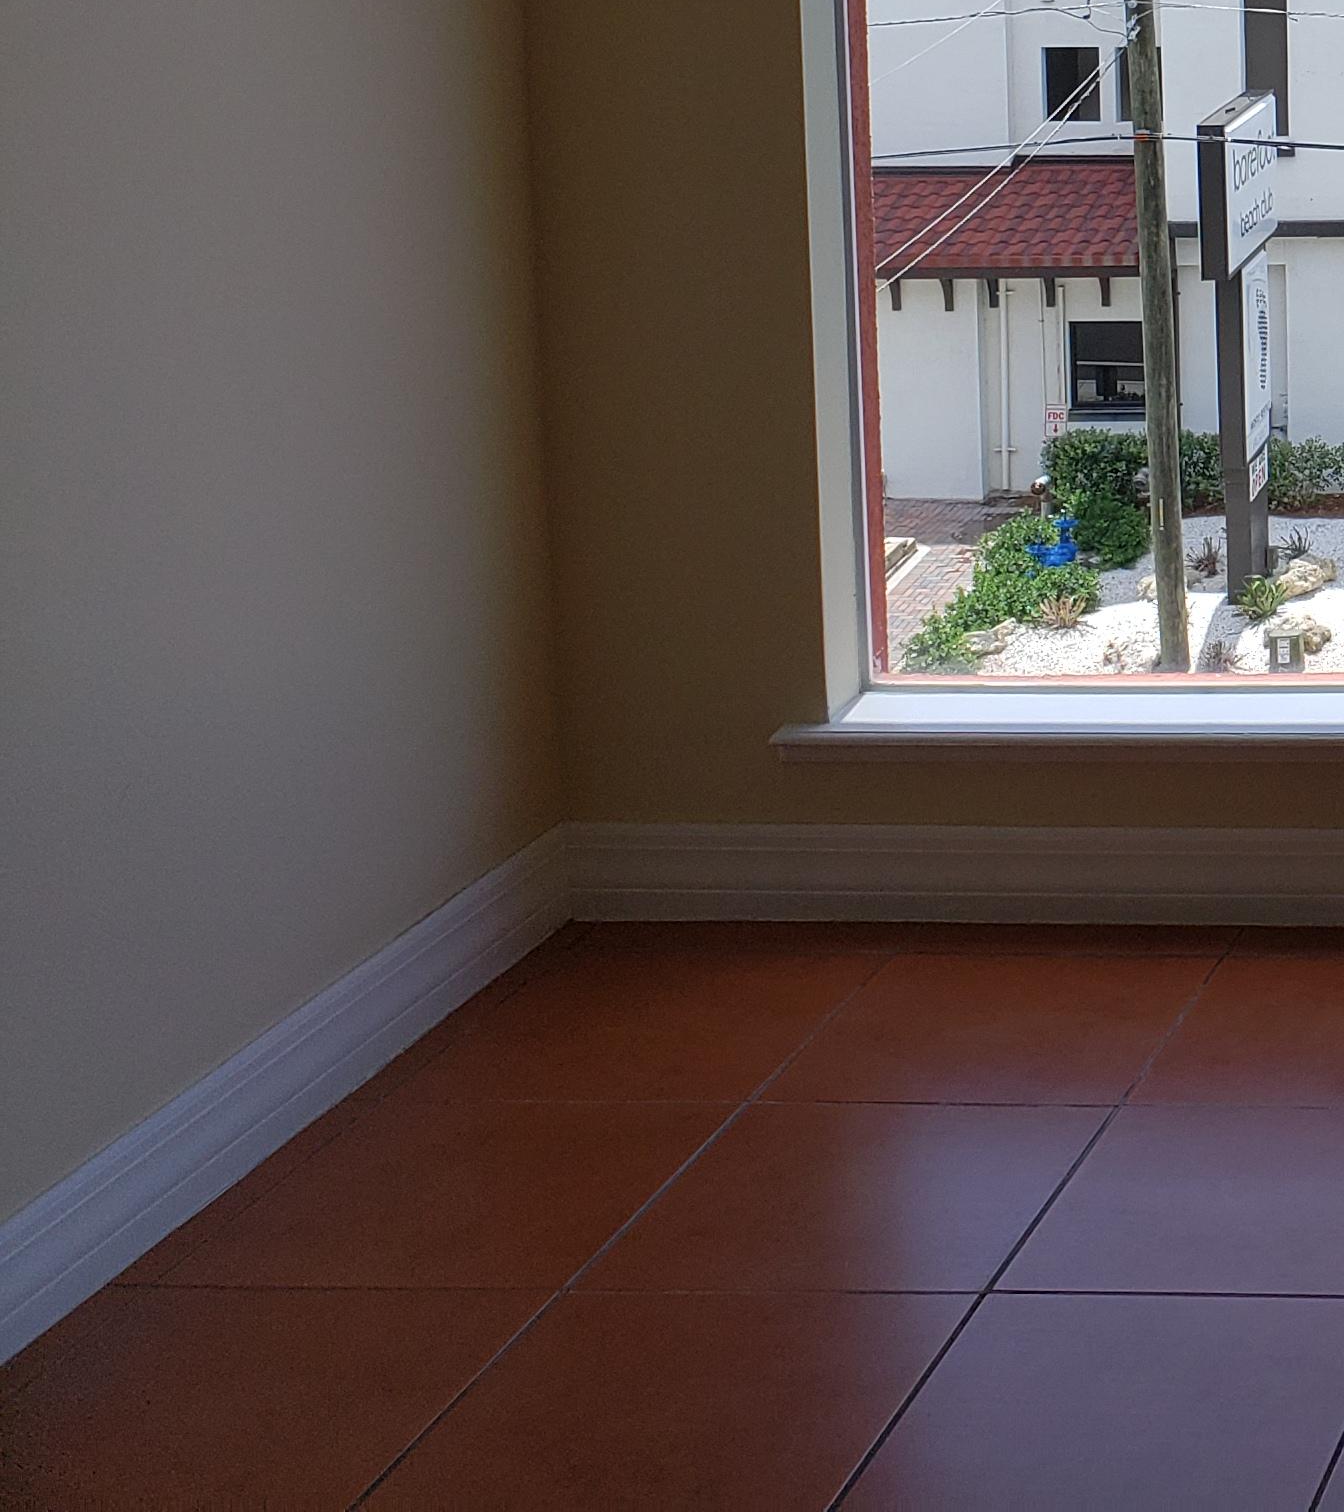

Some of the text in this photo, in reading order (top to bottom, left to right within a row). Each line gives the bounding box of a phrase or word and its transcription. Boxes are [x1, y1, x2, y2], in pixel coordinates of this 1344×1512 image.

[1240, 187, 1273, 237] beach club
[1047, 411, 1065, 420] FDC
